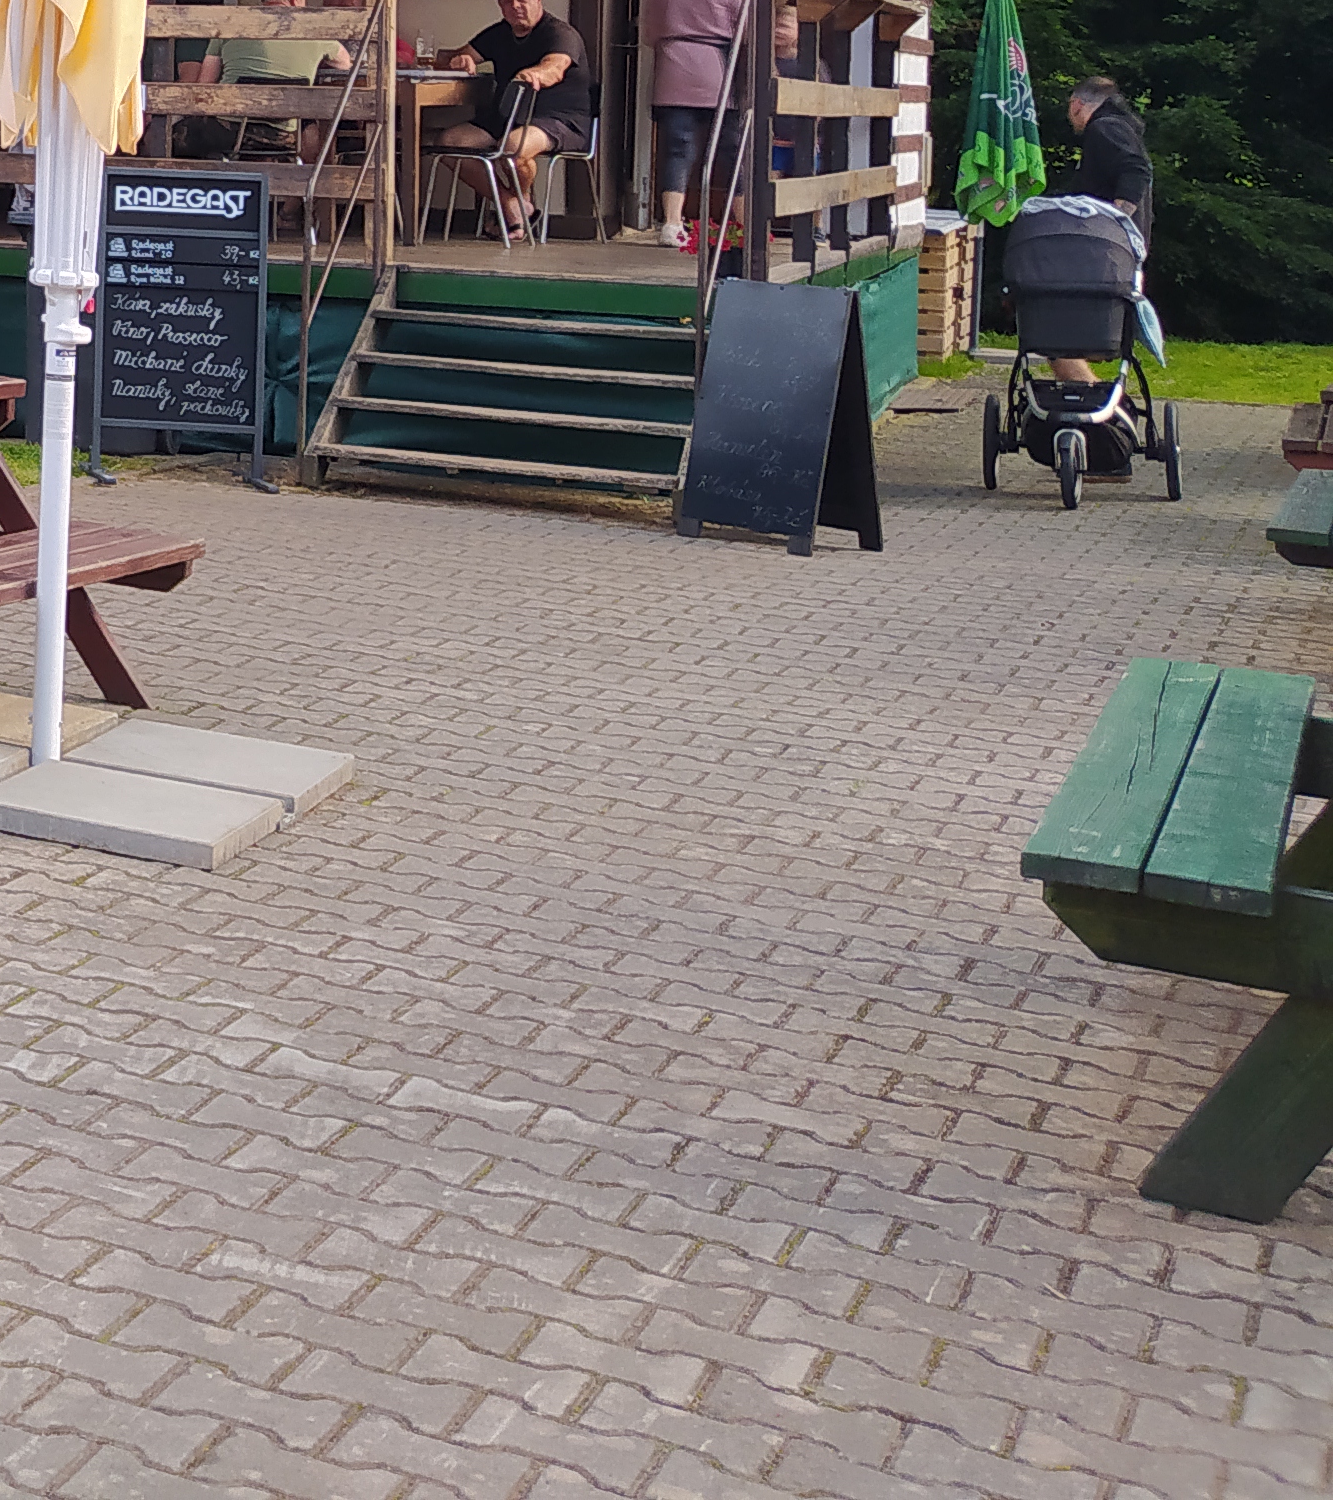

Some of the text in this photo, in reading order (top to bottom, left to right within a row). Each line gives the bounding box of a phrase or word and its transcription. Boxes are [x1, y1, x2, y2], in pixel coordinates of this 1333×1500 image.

[115, 185, 251, 218] RADEGAST
[131, 239, 174, 253] Radegast
[130, 264, 173, 277] Radegast
